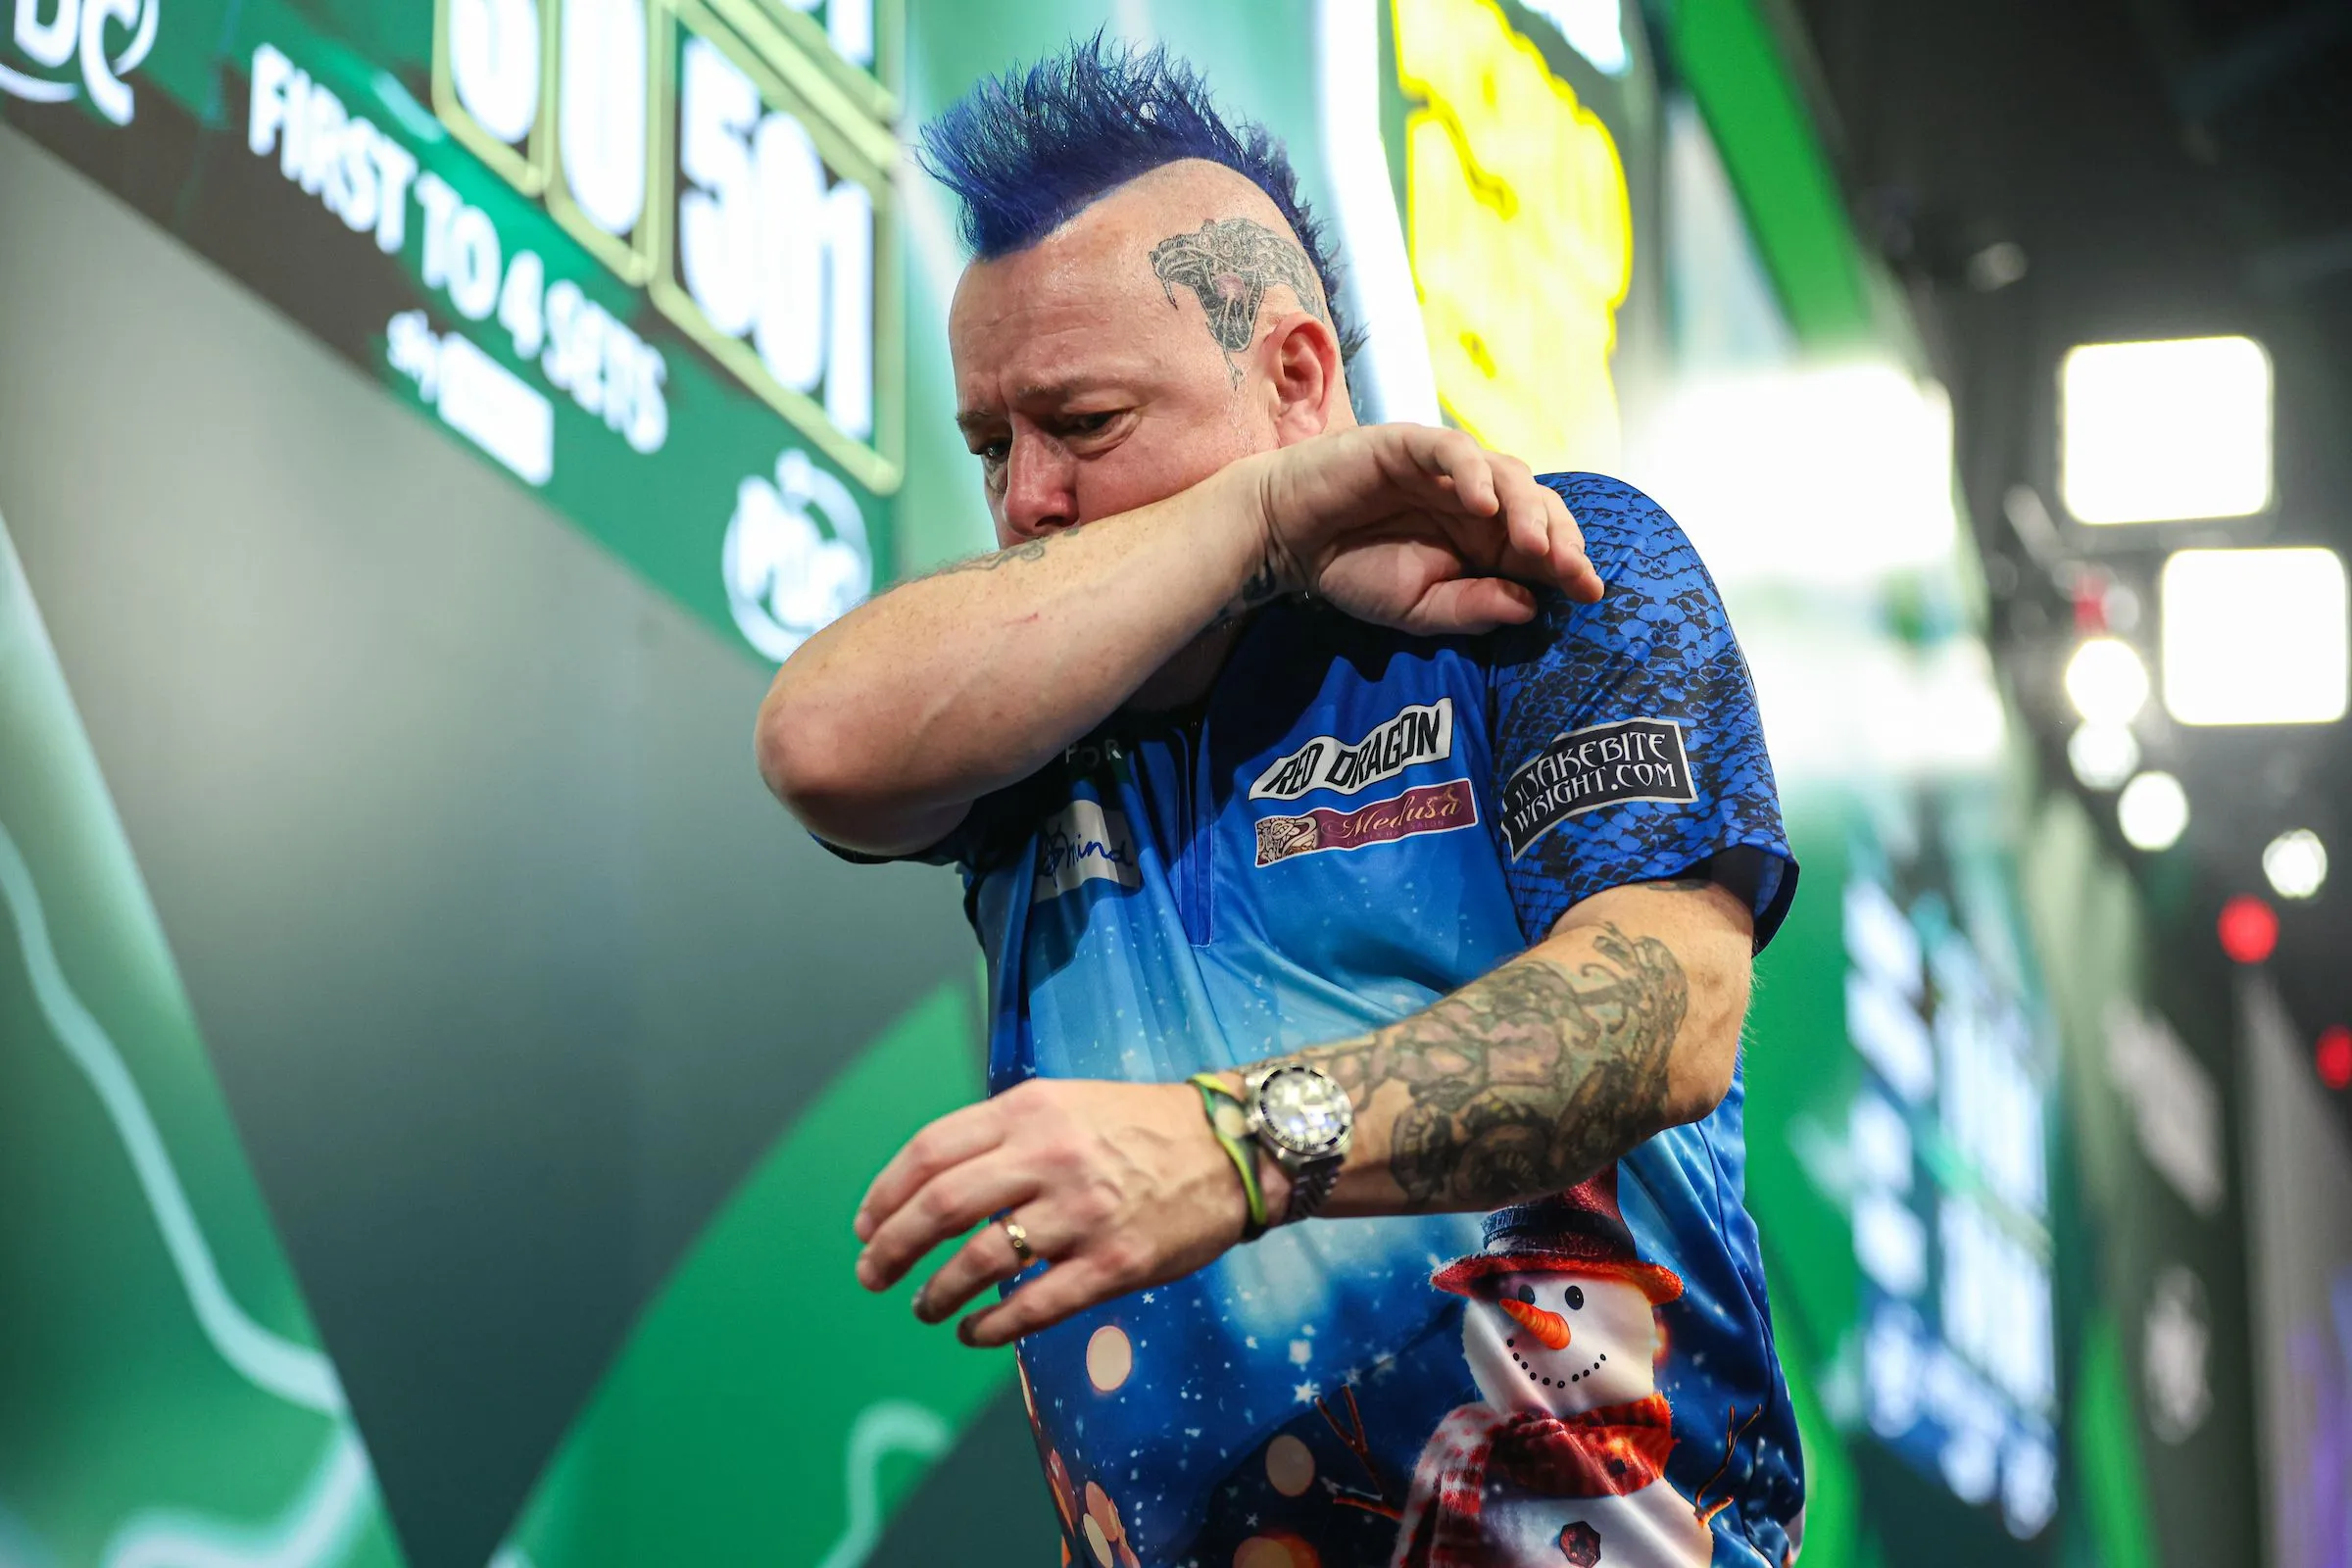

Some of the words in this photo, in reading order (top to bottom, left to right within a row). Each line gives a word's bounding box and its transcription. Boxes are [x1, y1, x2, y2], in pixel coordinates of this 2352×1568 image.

[249, 42, 417, 255] FIRST
[415, 171, 503, 320] TO
[498, 249, 545, 361] 4
[541, 278, 668, 454] SETS
[680, 35, 875, 441] 501
[1261, 743, 1324, 795] RED
[1324, 709, 1441, 790] DRAGON
[1326, 787, 1462, 840] Medusa
[1514, 763, 1677, 833] WRIGHT.COM
